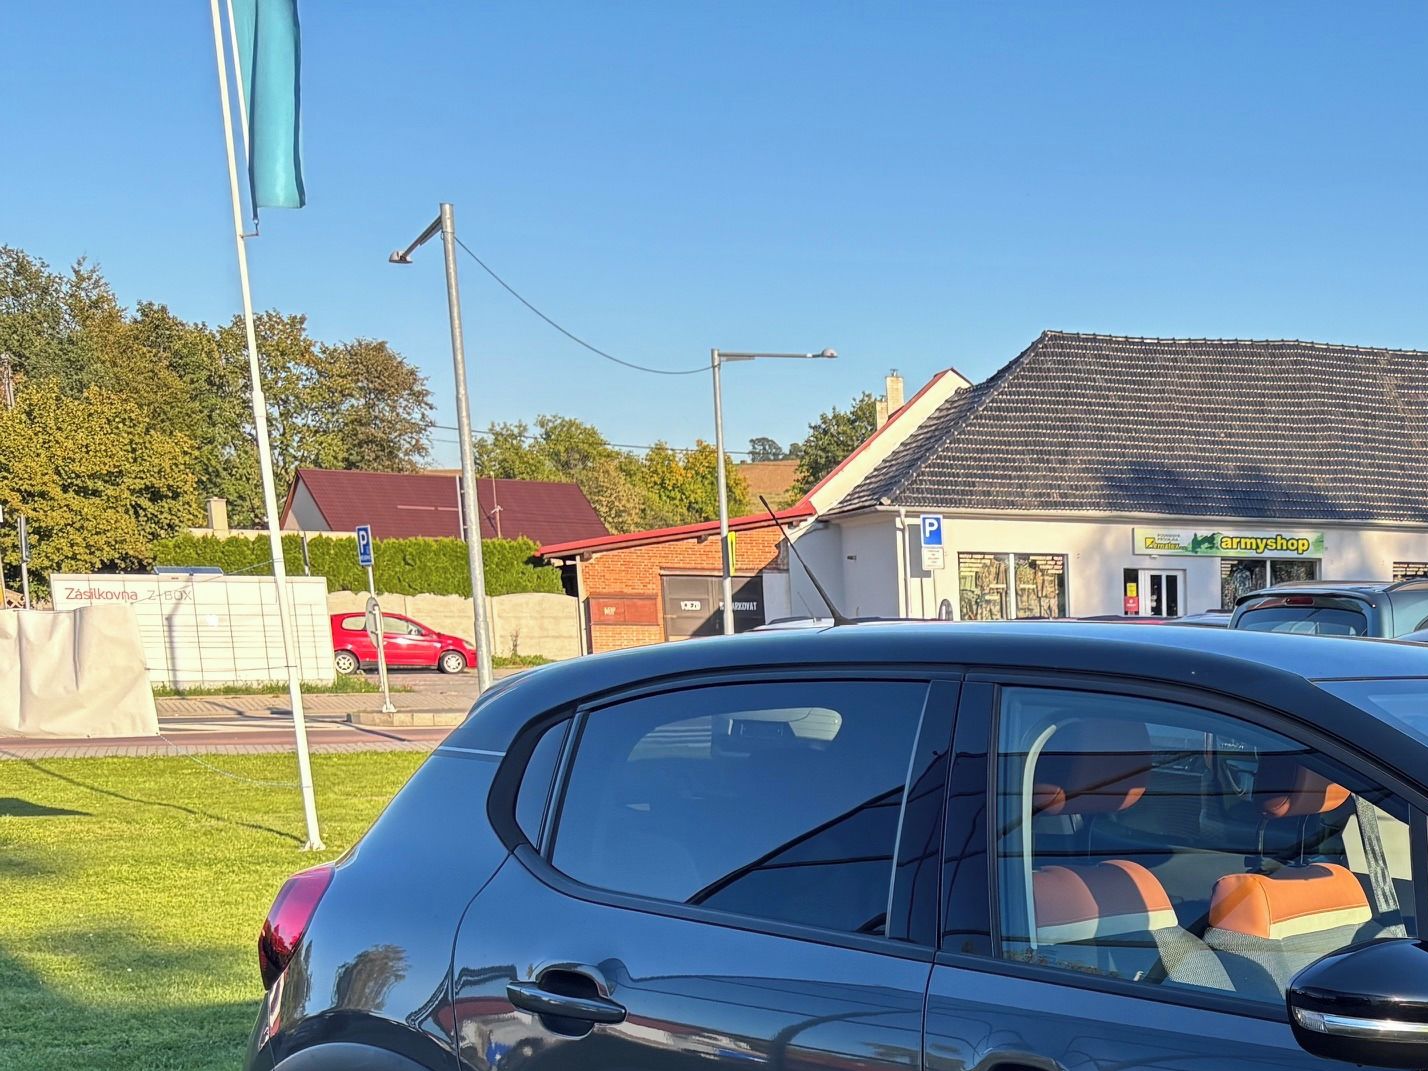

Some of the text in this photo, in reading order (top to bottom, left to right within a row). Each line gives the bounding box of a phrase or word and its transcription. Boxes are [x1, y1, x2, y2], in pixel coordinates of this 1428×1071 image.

[925, 518, 939, 538] P
[359, 530, 368, 553] P
[1220, 534, 1310, 555] armyshop
[65, 587, 138, 600] Zásilkovna
